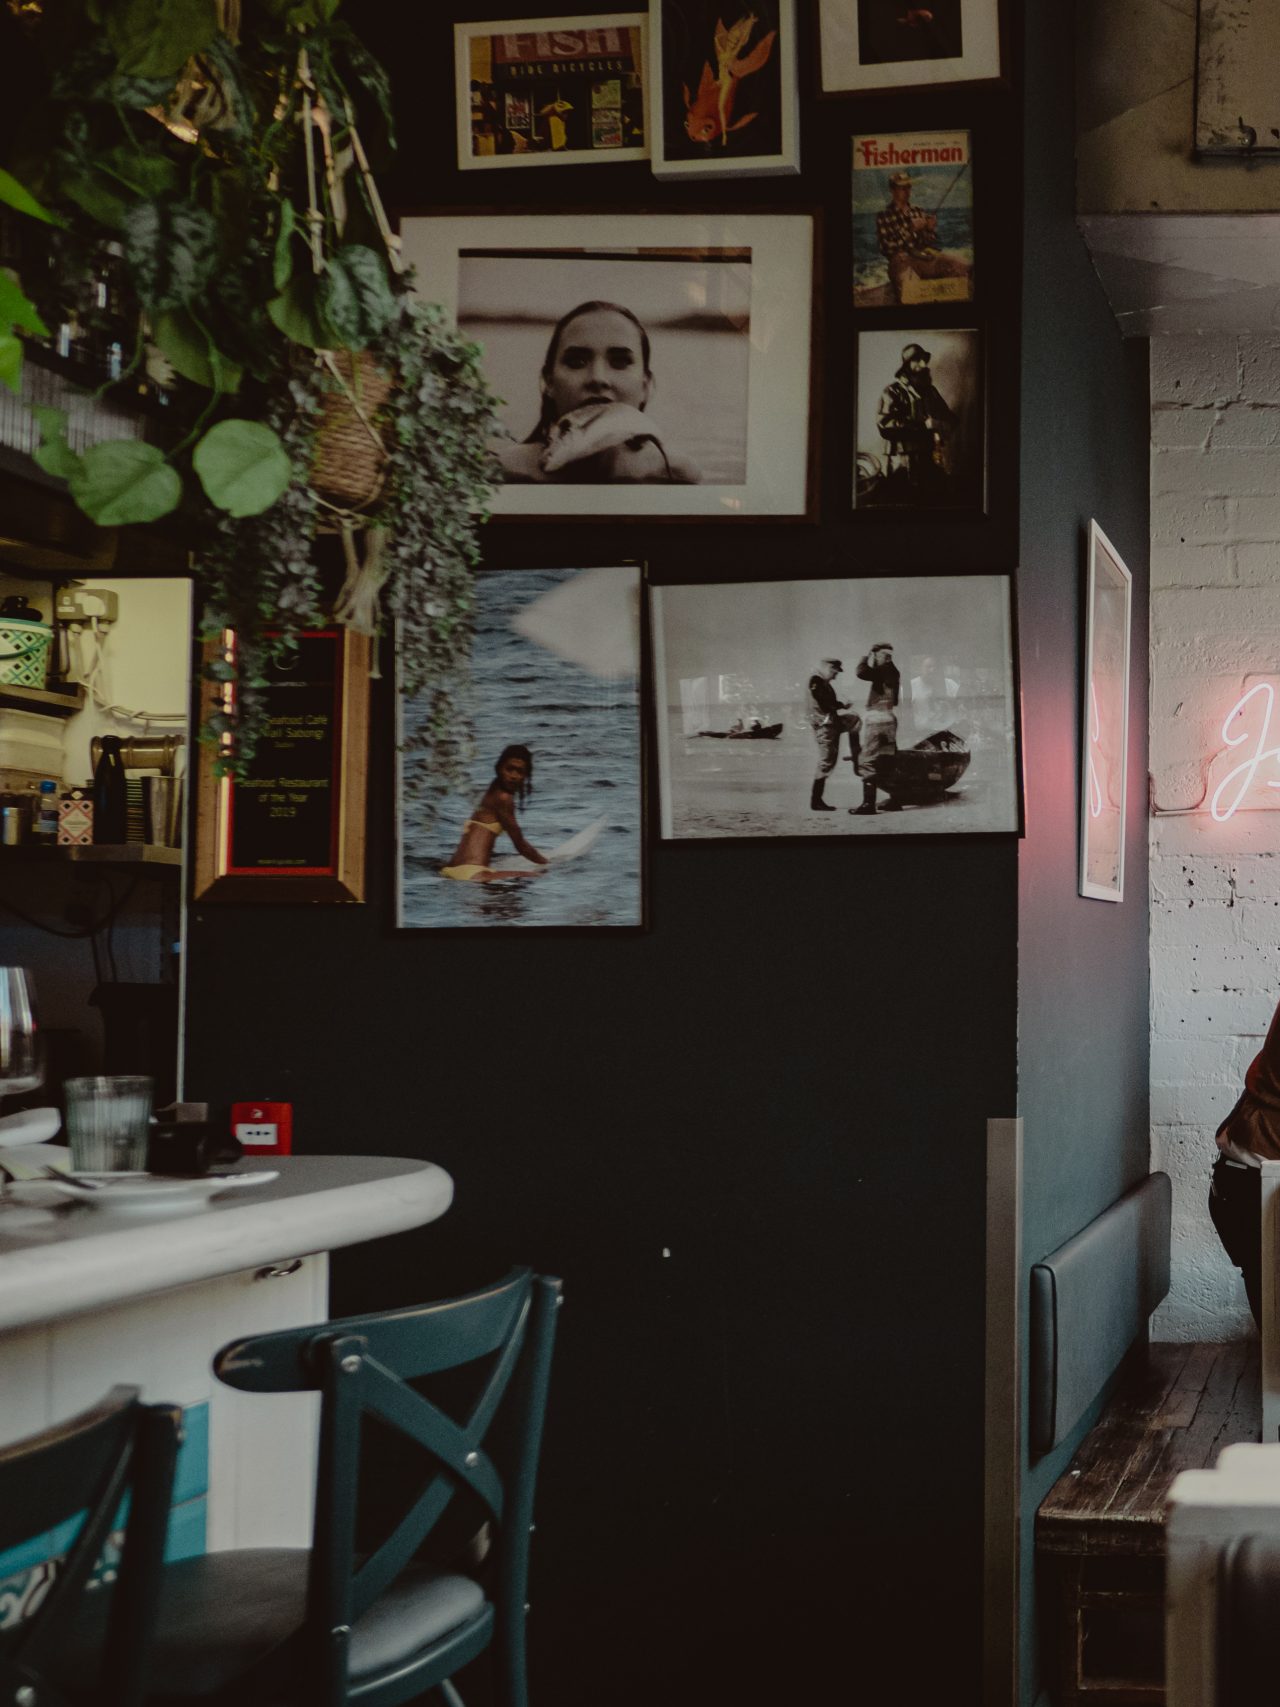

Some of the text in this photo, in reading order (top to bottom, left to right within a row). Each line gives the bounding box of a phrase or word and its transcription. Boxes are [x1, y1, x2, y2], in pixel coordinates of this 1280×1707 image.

[503, 29, 622, 58] FISH
[861, 140, 962, 166] Fisherman
[279, 777, 328, 788] Restaurant
